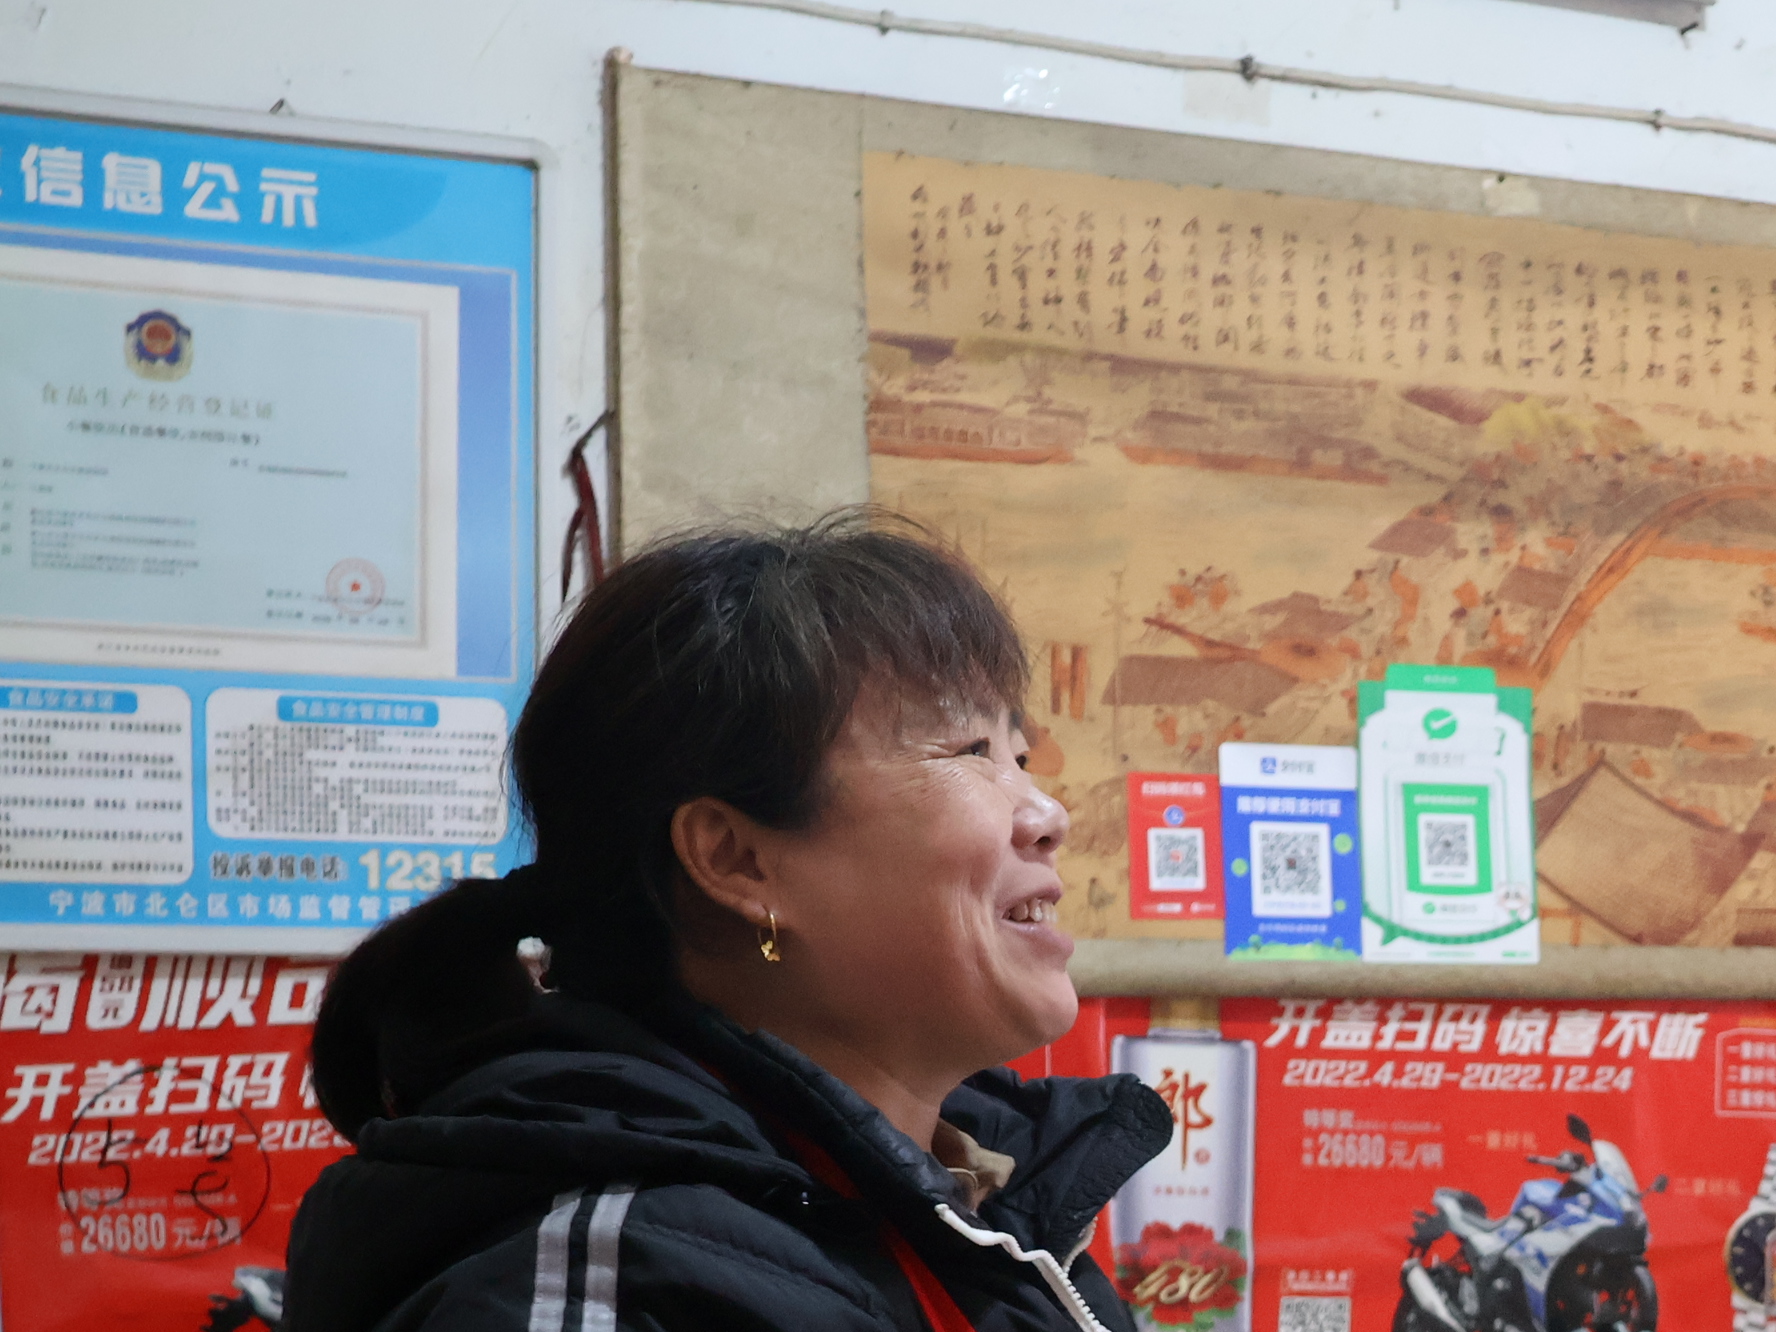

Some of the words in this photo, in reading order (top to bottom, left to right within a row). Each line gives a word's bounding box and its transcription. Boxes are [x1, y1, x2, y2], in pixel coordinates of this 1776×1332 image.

[20, 144, 318, 228] 信息公示
[358, 848, 498, 892] 12315
[1263, 1000, 1492, 1053] 开盖扫码
[1494, 1005, 1709, 1061] 惊喜不断
[0, 1052, 290, 1123] 开盖扫码
[79, 1212, 167, 1255] 26680
